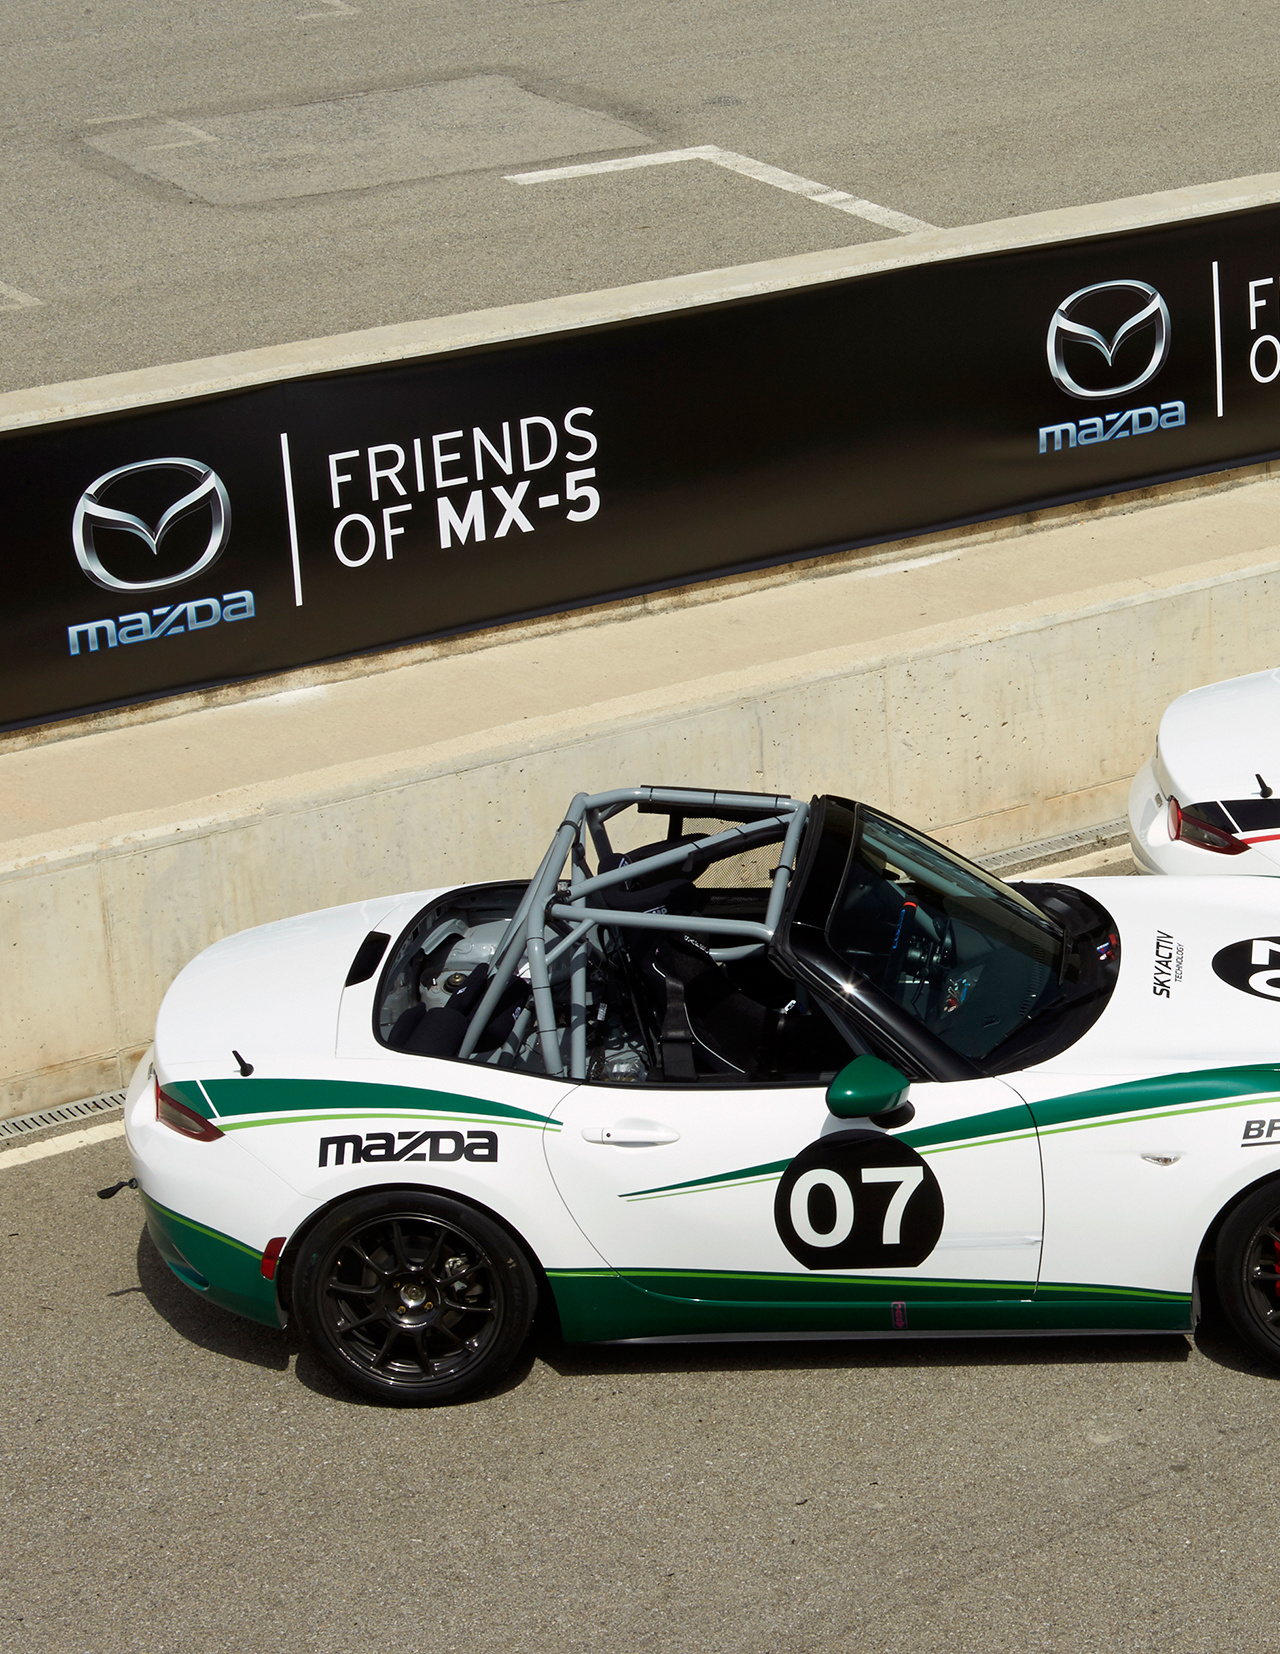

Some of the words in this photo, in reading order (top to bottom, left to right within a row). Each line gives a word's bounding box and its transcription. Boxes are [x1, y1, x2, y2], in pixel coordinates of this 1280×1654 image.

[328, 406, 599, 508] FRIENDS
[333, 503, 413, 567] OF
[437, 467, 601, 549] MX-5
[1153, 930, 1174, 999] SKYACTIV
[1174, 943, 1185, 983] TECHNOLOGY
[789, 1165, 925, 1249] 07
